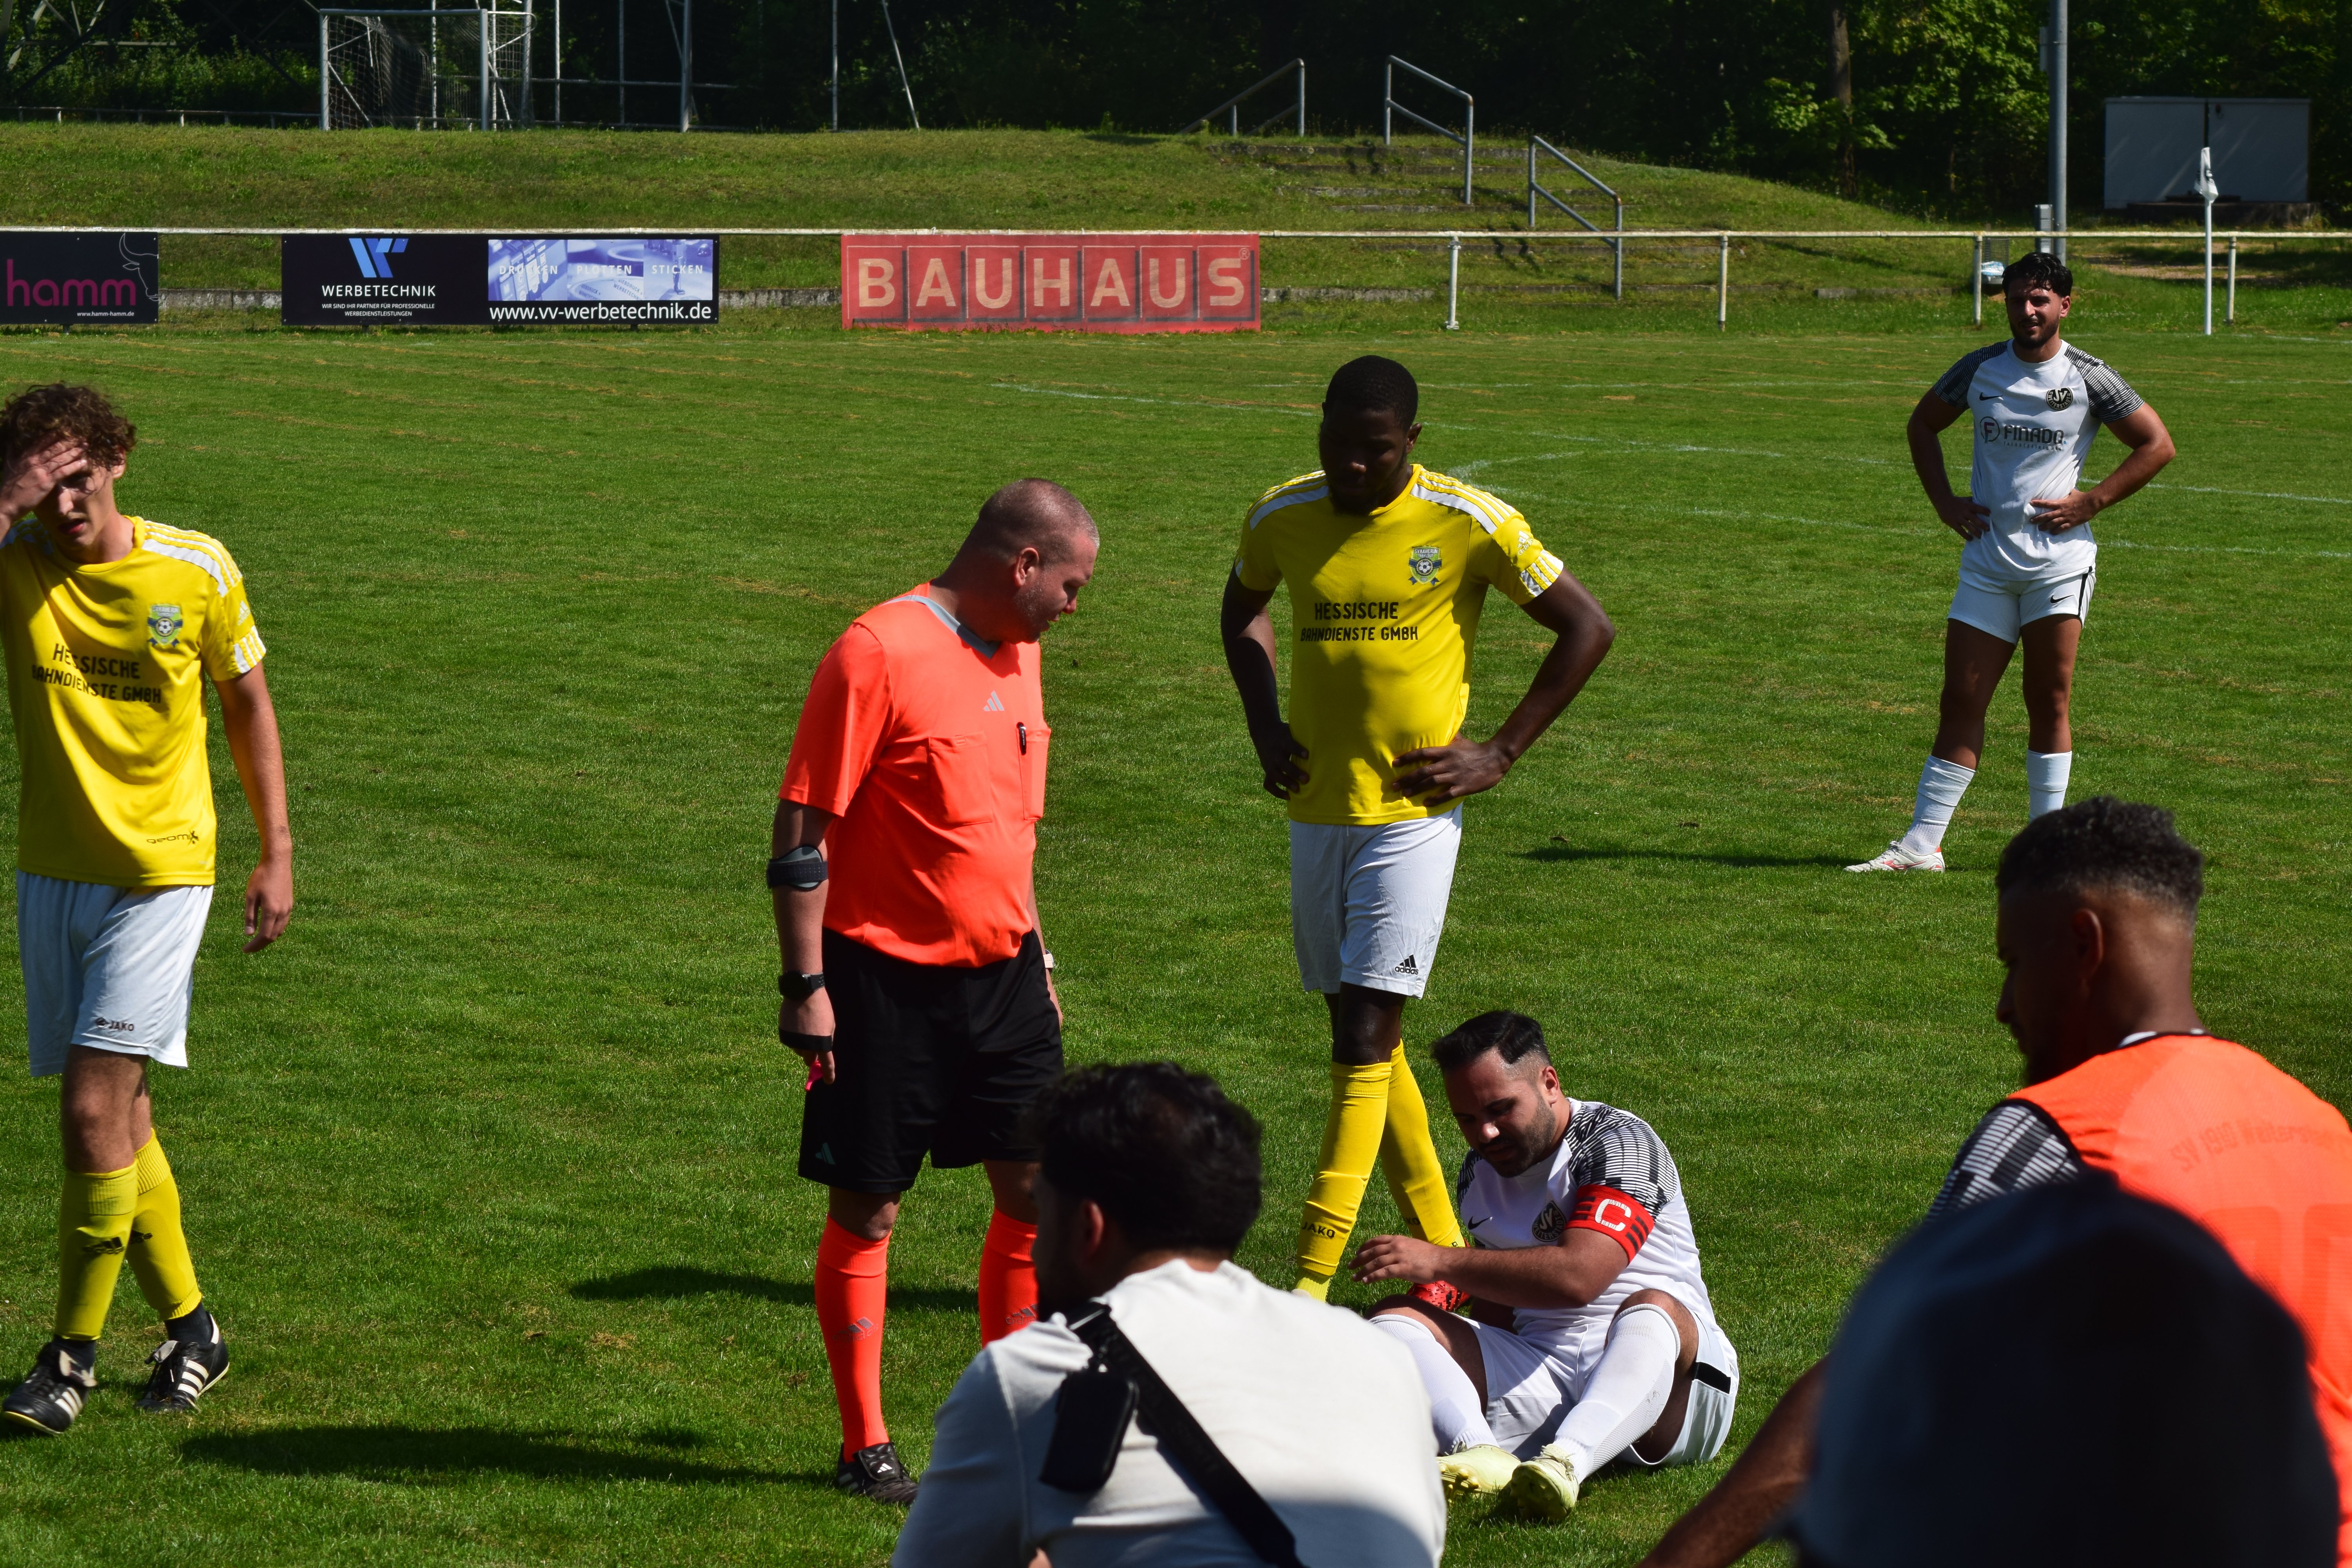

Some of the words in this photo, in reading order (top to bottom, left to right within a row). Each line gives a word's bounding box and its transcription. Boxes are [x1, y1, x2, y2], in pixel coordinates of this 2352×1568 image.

[577, 265, 632, 274] PLOTTEN
[652, 265, 703, 274] STICKEN
[7, 259, 136, 306] hamm
[858, 258, 1244, 309] BAUHAUS
[322, 285, 436, 297] WERBETECHNIK
[490, 303, 711, 319] www.vv-werbetechnik.de
[2054, 389, 2068, 402] SV
[1315, 602, 1399, 620] HESSISCHE
[1300, 626, 1374, 641] BAHNDIENSTE
[1381, 626, 1418, 641] GMBH
[53, 643, 140, 679] HESSISCHE
[122, 686, 161, 704] GMBH
[1595, 1198, 1632, 1231] C
[1302, 1222, 1335, 1238] JAKO
